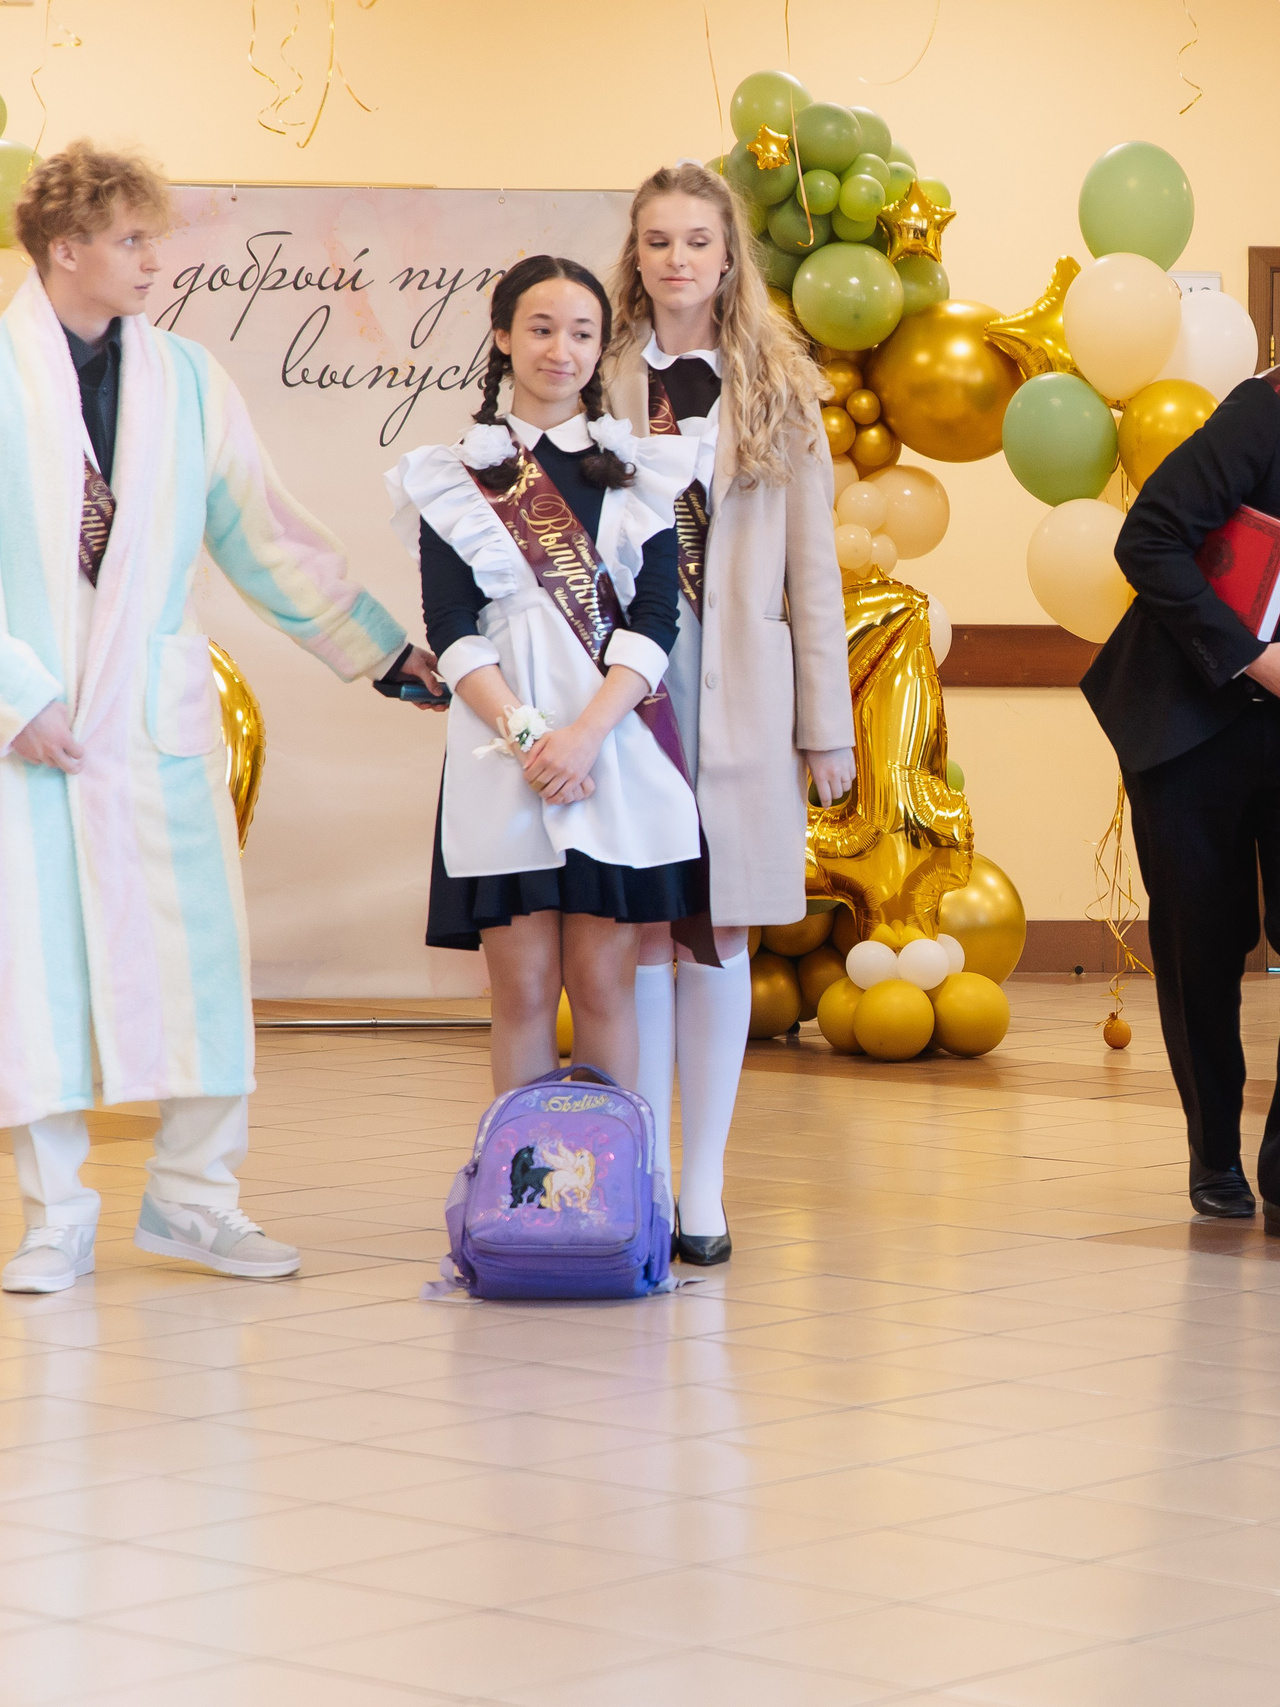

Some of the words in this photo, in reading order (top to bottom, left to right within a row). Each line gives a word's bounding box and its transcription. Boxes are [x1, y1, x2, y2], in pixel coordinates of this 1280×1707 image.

[153, 230, 375, 342] добрый
[281, 304, 492, 448] выпуск
[519, 493, 612, 641] Выпускниц
